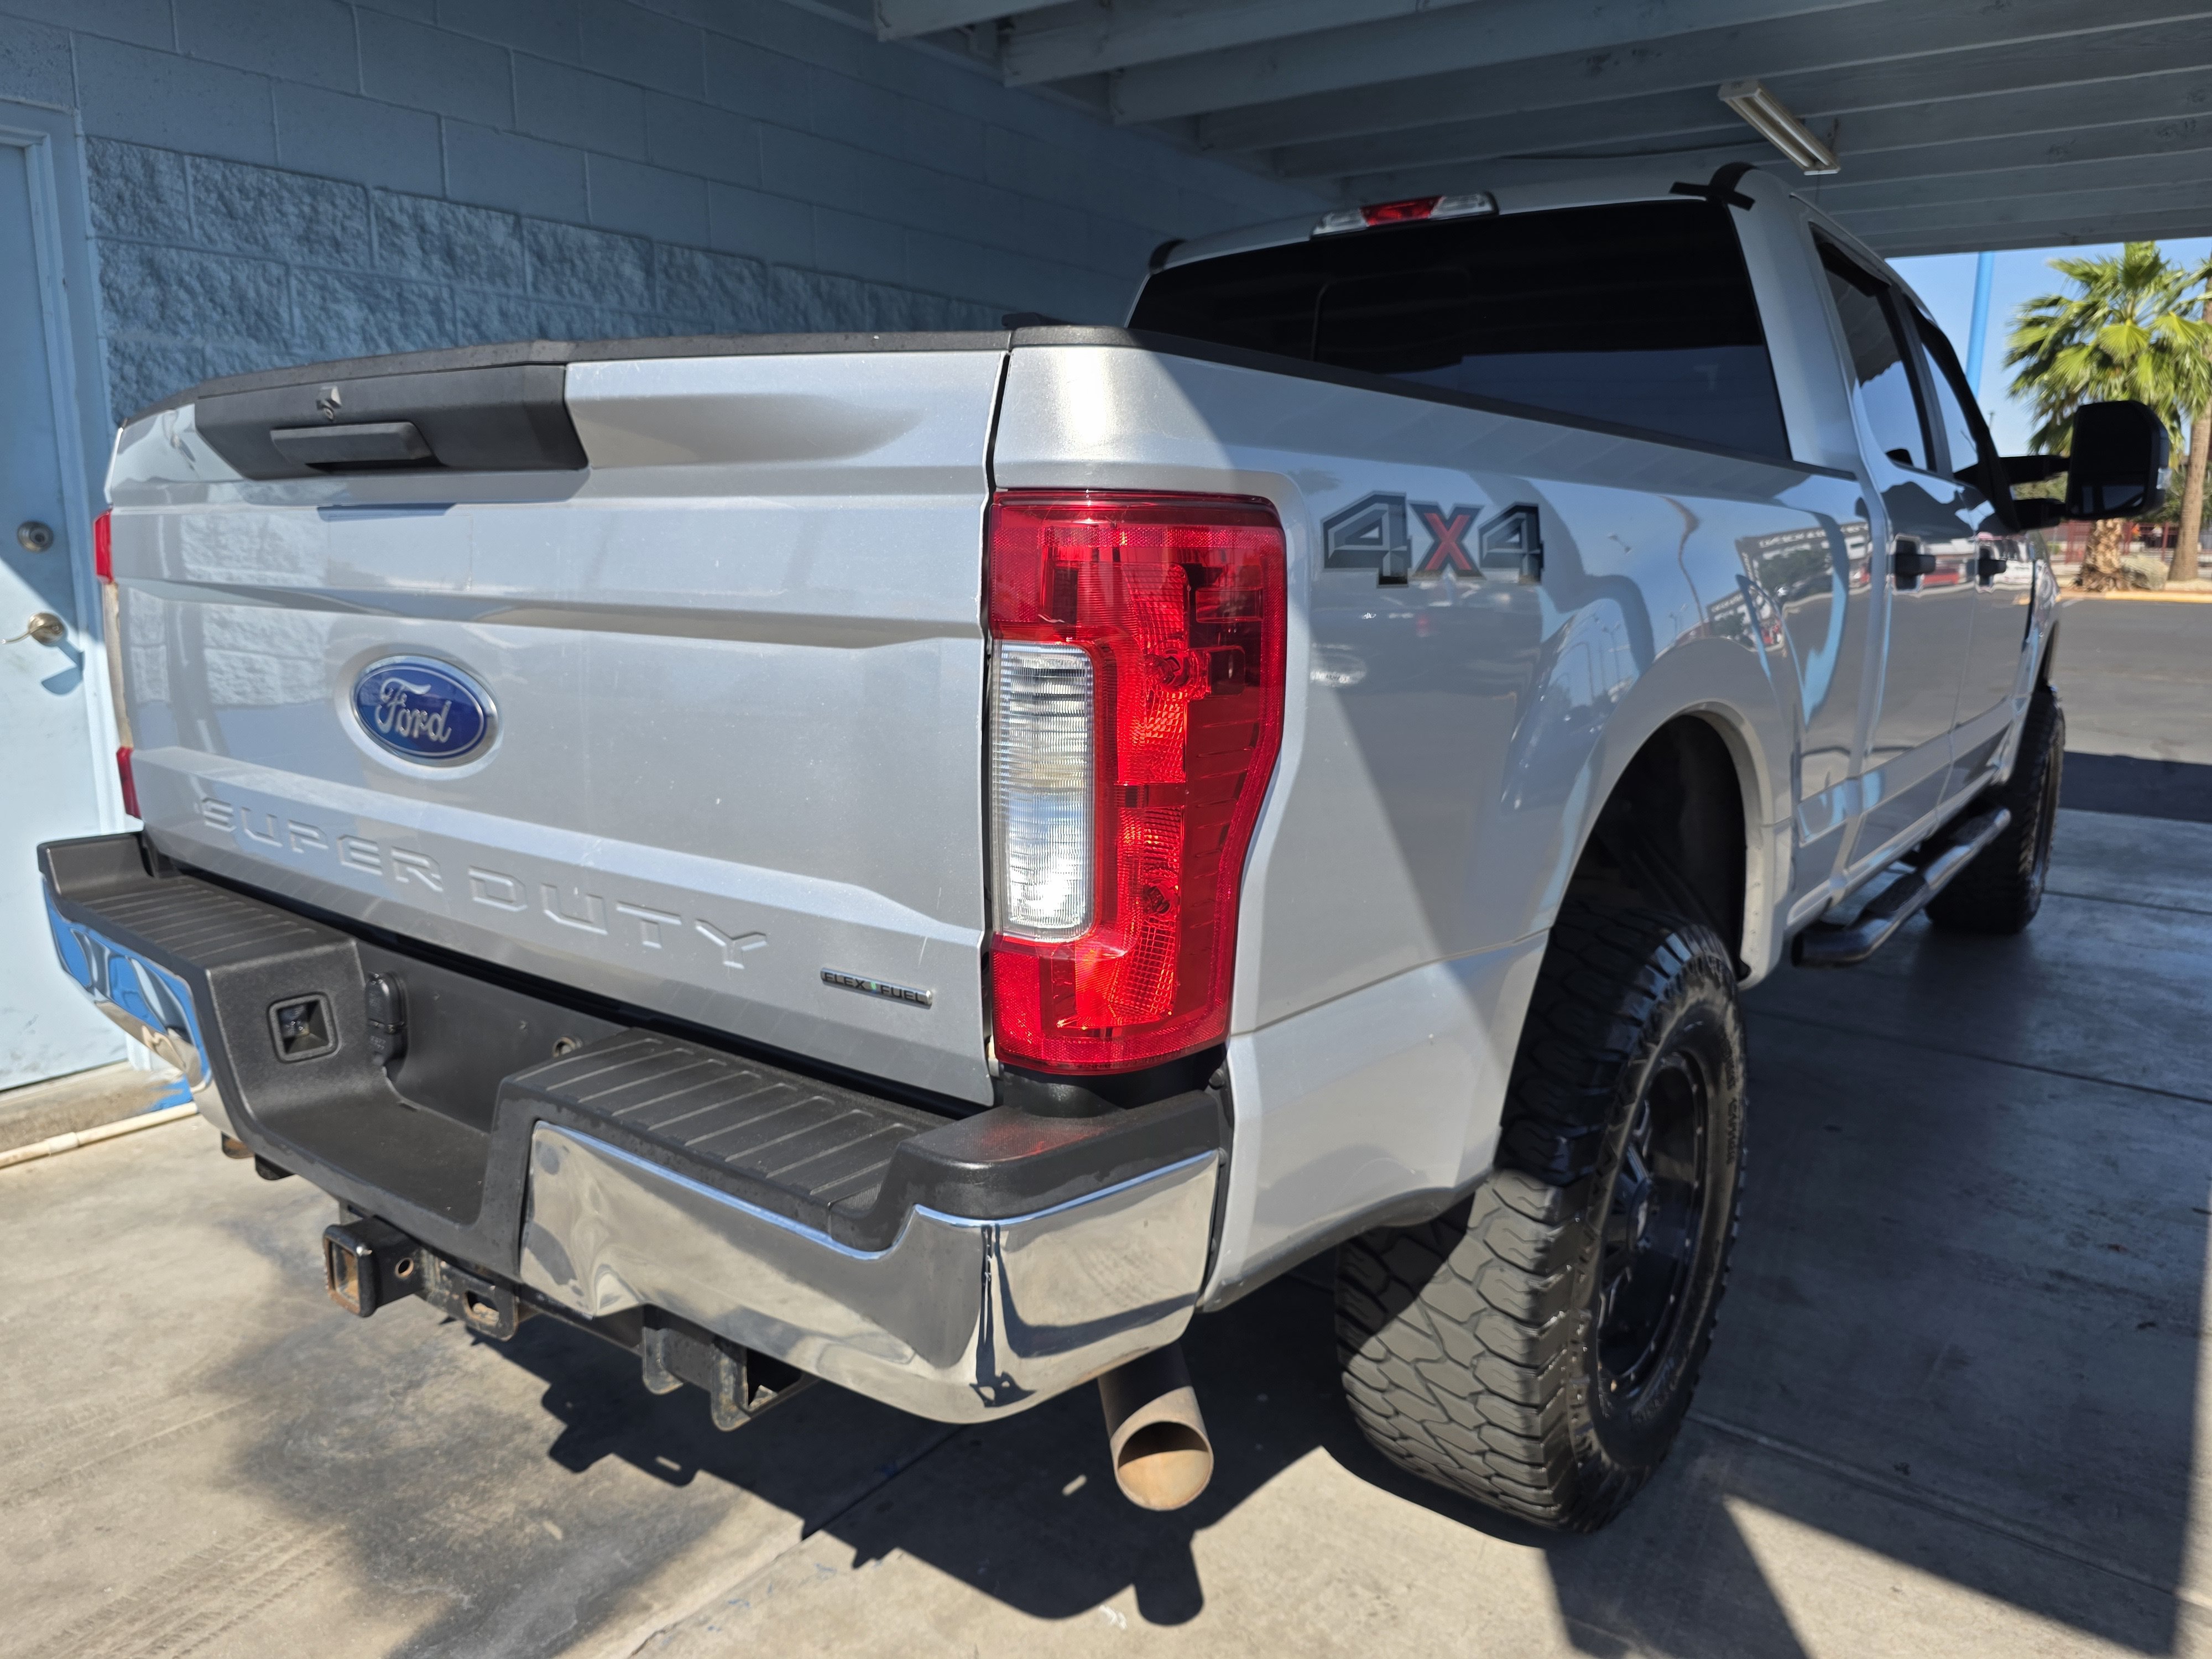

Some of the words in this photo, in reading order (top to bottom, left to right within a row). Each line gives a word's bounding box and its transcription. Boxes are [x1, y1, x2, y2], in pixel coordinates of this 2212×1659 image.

[374, 677, 453, 743] Ford
[201, 796, 444, 892] SUPER
[467, 865, 769, 969] DUTY
[824, 972, 866, 990] FLEX
[880, 984, 927, 1005] FUEL
